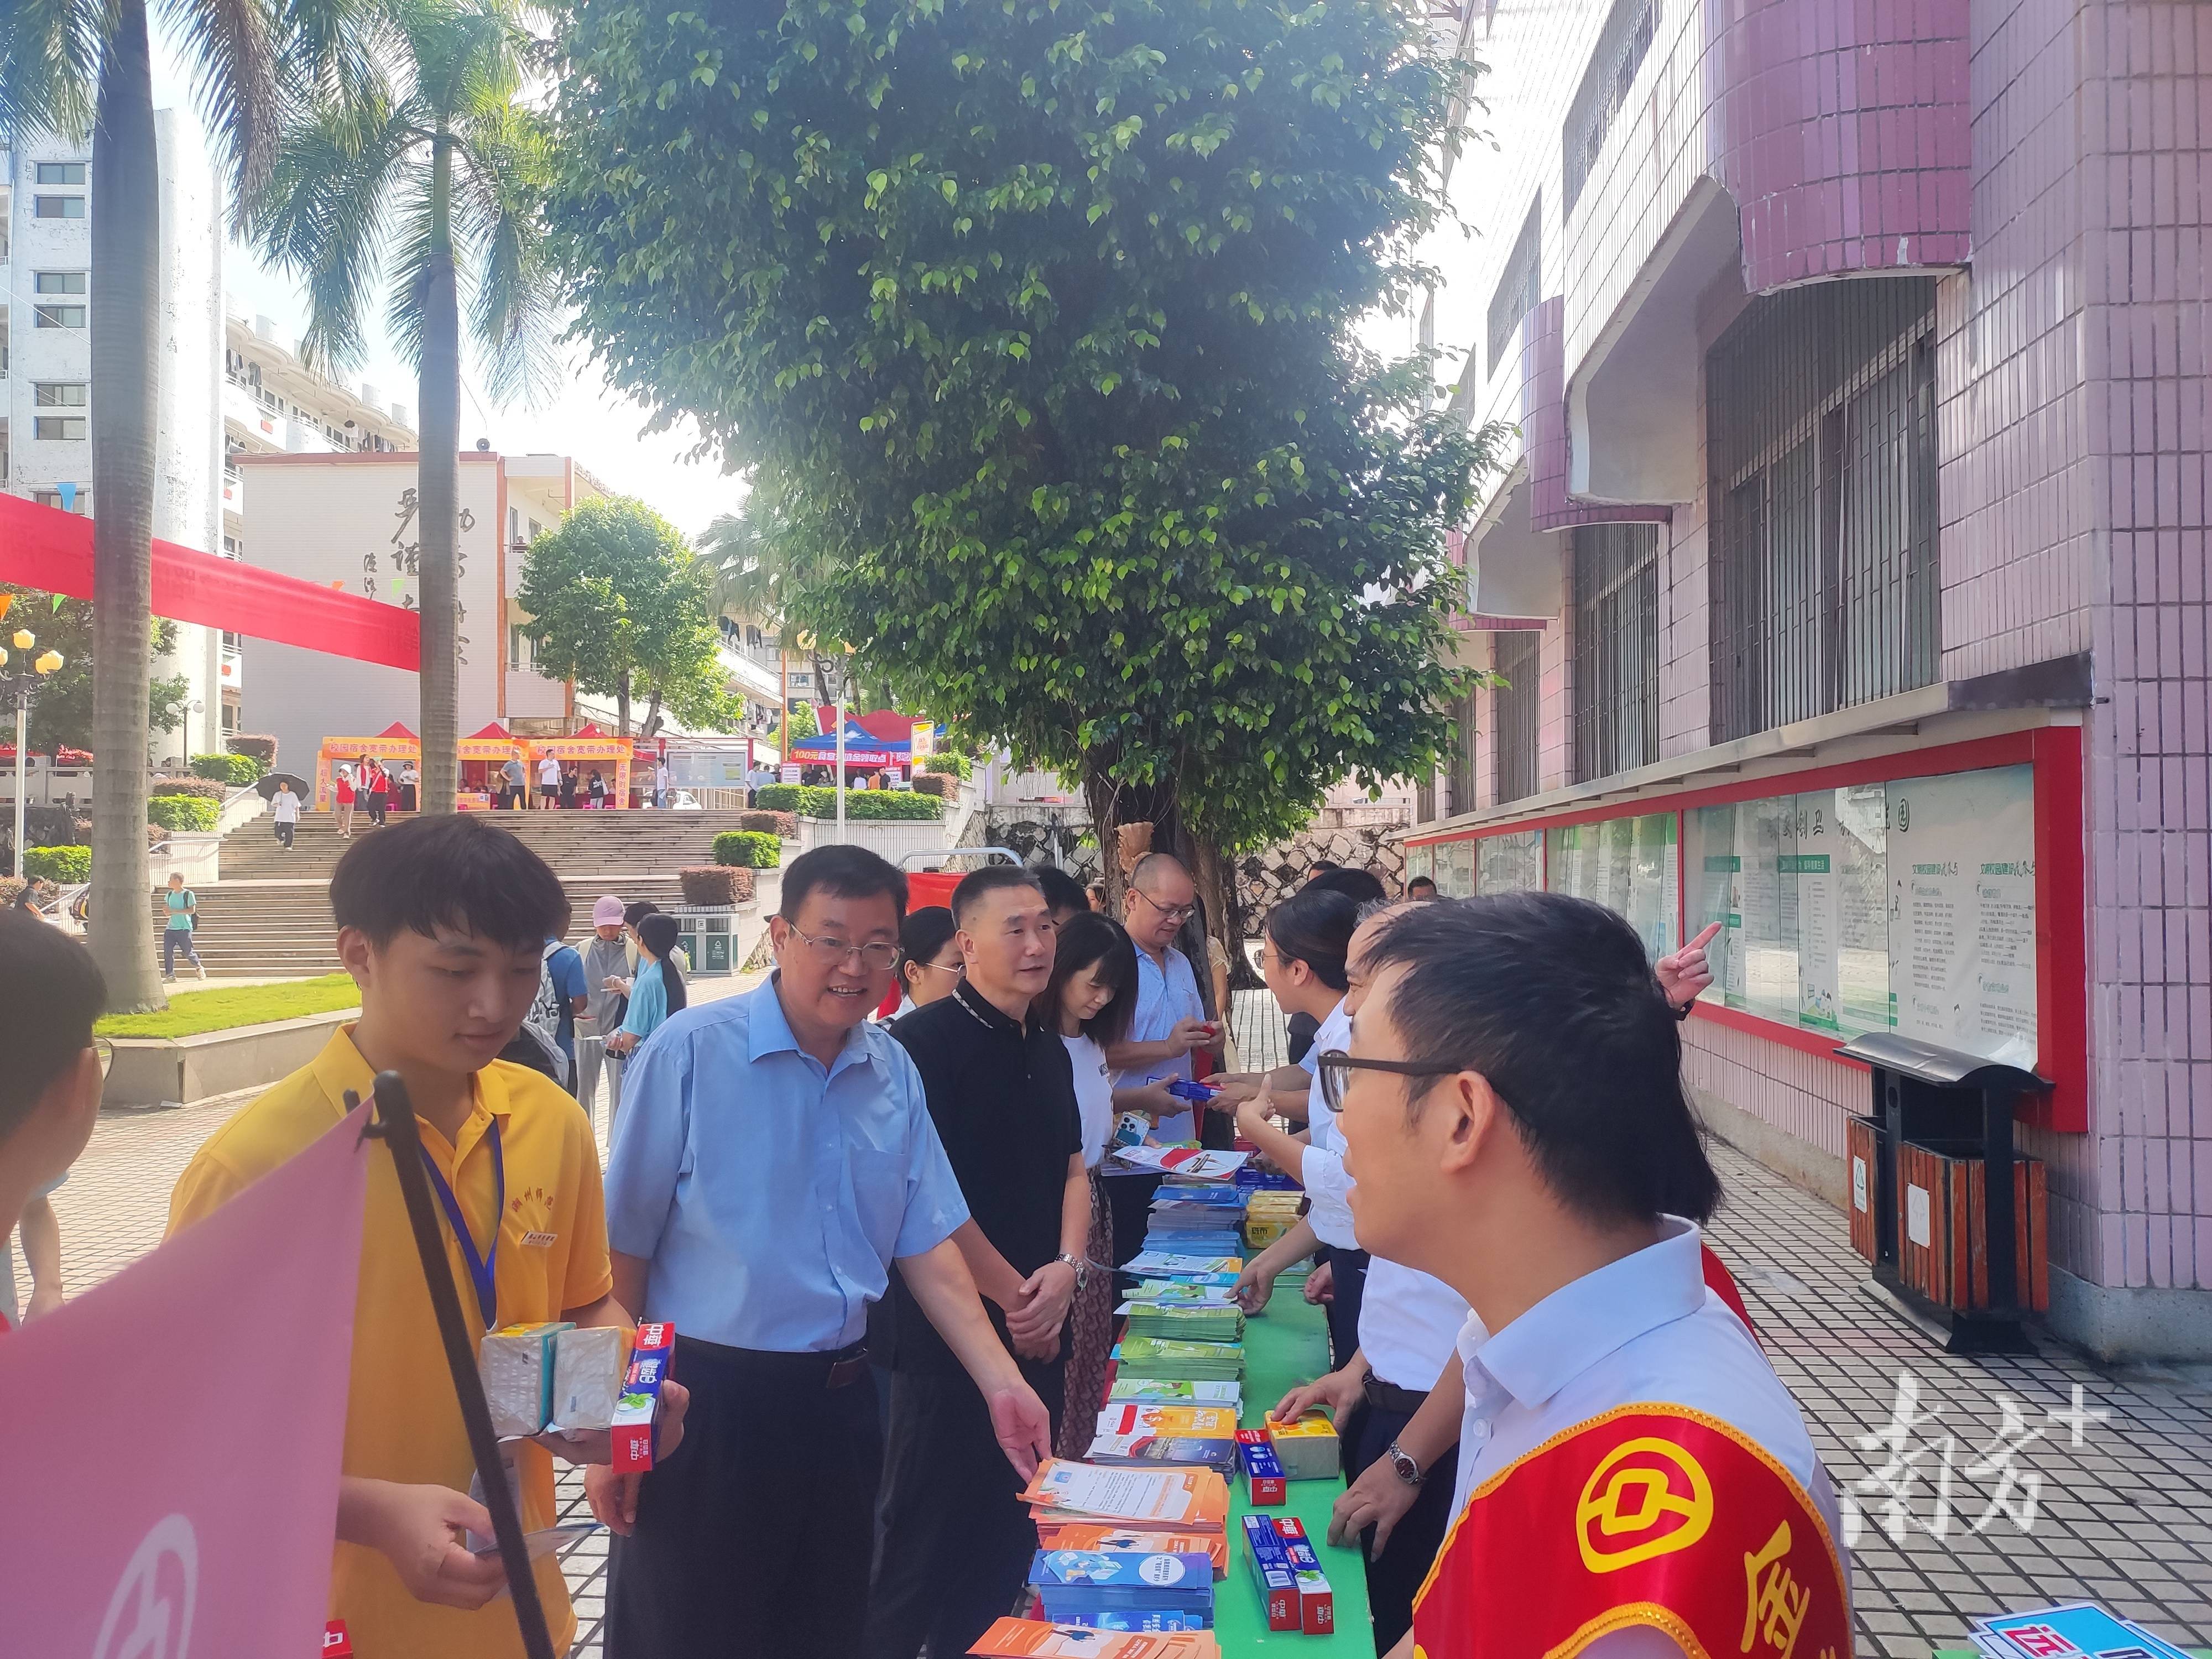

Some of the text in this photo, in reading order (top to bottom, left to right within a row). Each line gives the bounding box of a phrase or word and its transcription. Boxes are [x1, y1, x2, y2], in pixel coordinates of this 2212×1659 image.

[330, 743, 417, 754] 校园宿舍宽带办理处
[794, 749, 887, 763] 100元食堂值金领取点
[1740, 1519, 1836, 1659] 金
[2005, 1625, 2089, 1659] 远
